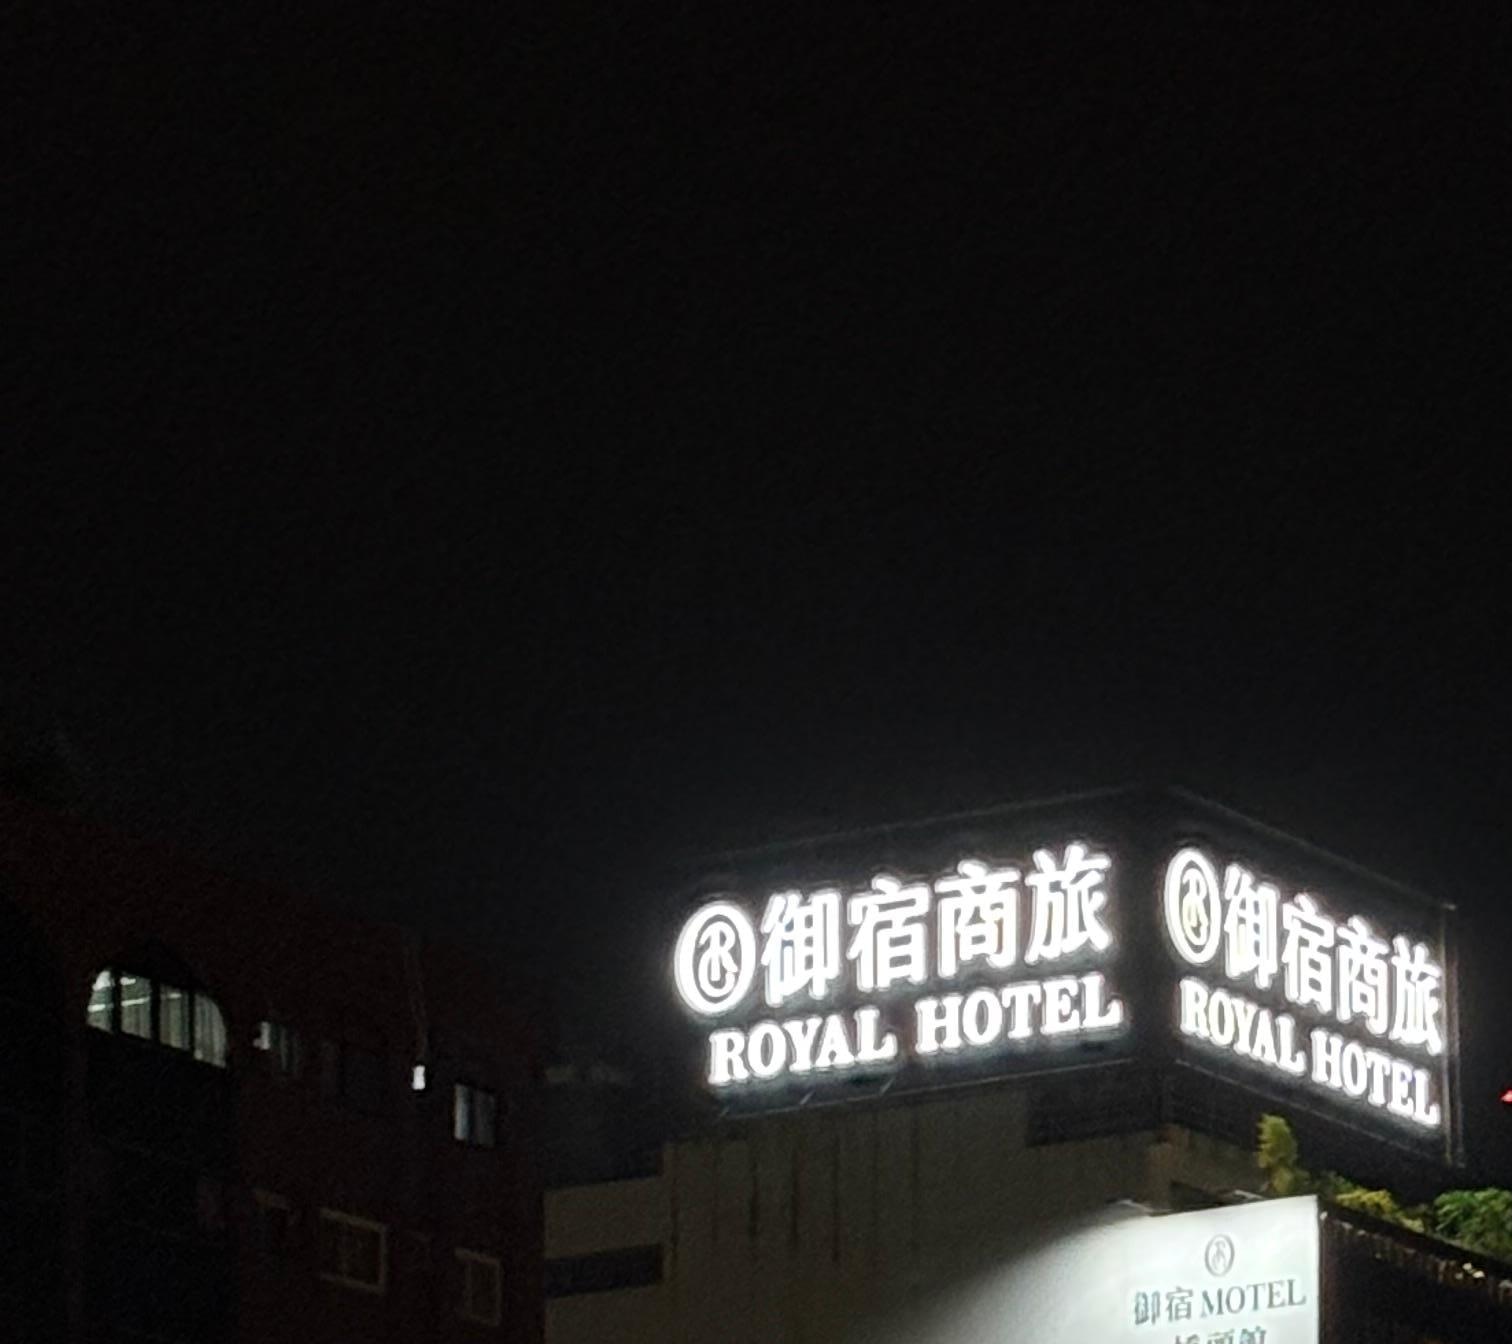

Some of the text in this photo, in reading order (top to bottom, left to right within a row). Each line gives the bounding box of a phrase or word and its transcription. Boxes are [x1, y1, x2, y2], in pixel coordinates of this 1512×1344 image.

[762, 842, 1112, 1004] 御宿商旅
[1223, 864, 1443, 1056] 御宿商旅
[709, 972, 1124, 1085] ROYAL HOTEL
[1178, 978, 1440, 1128] ROYAL HOTEL
[1134, 1278, 1306, 1325] 御宿 MOTEL
